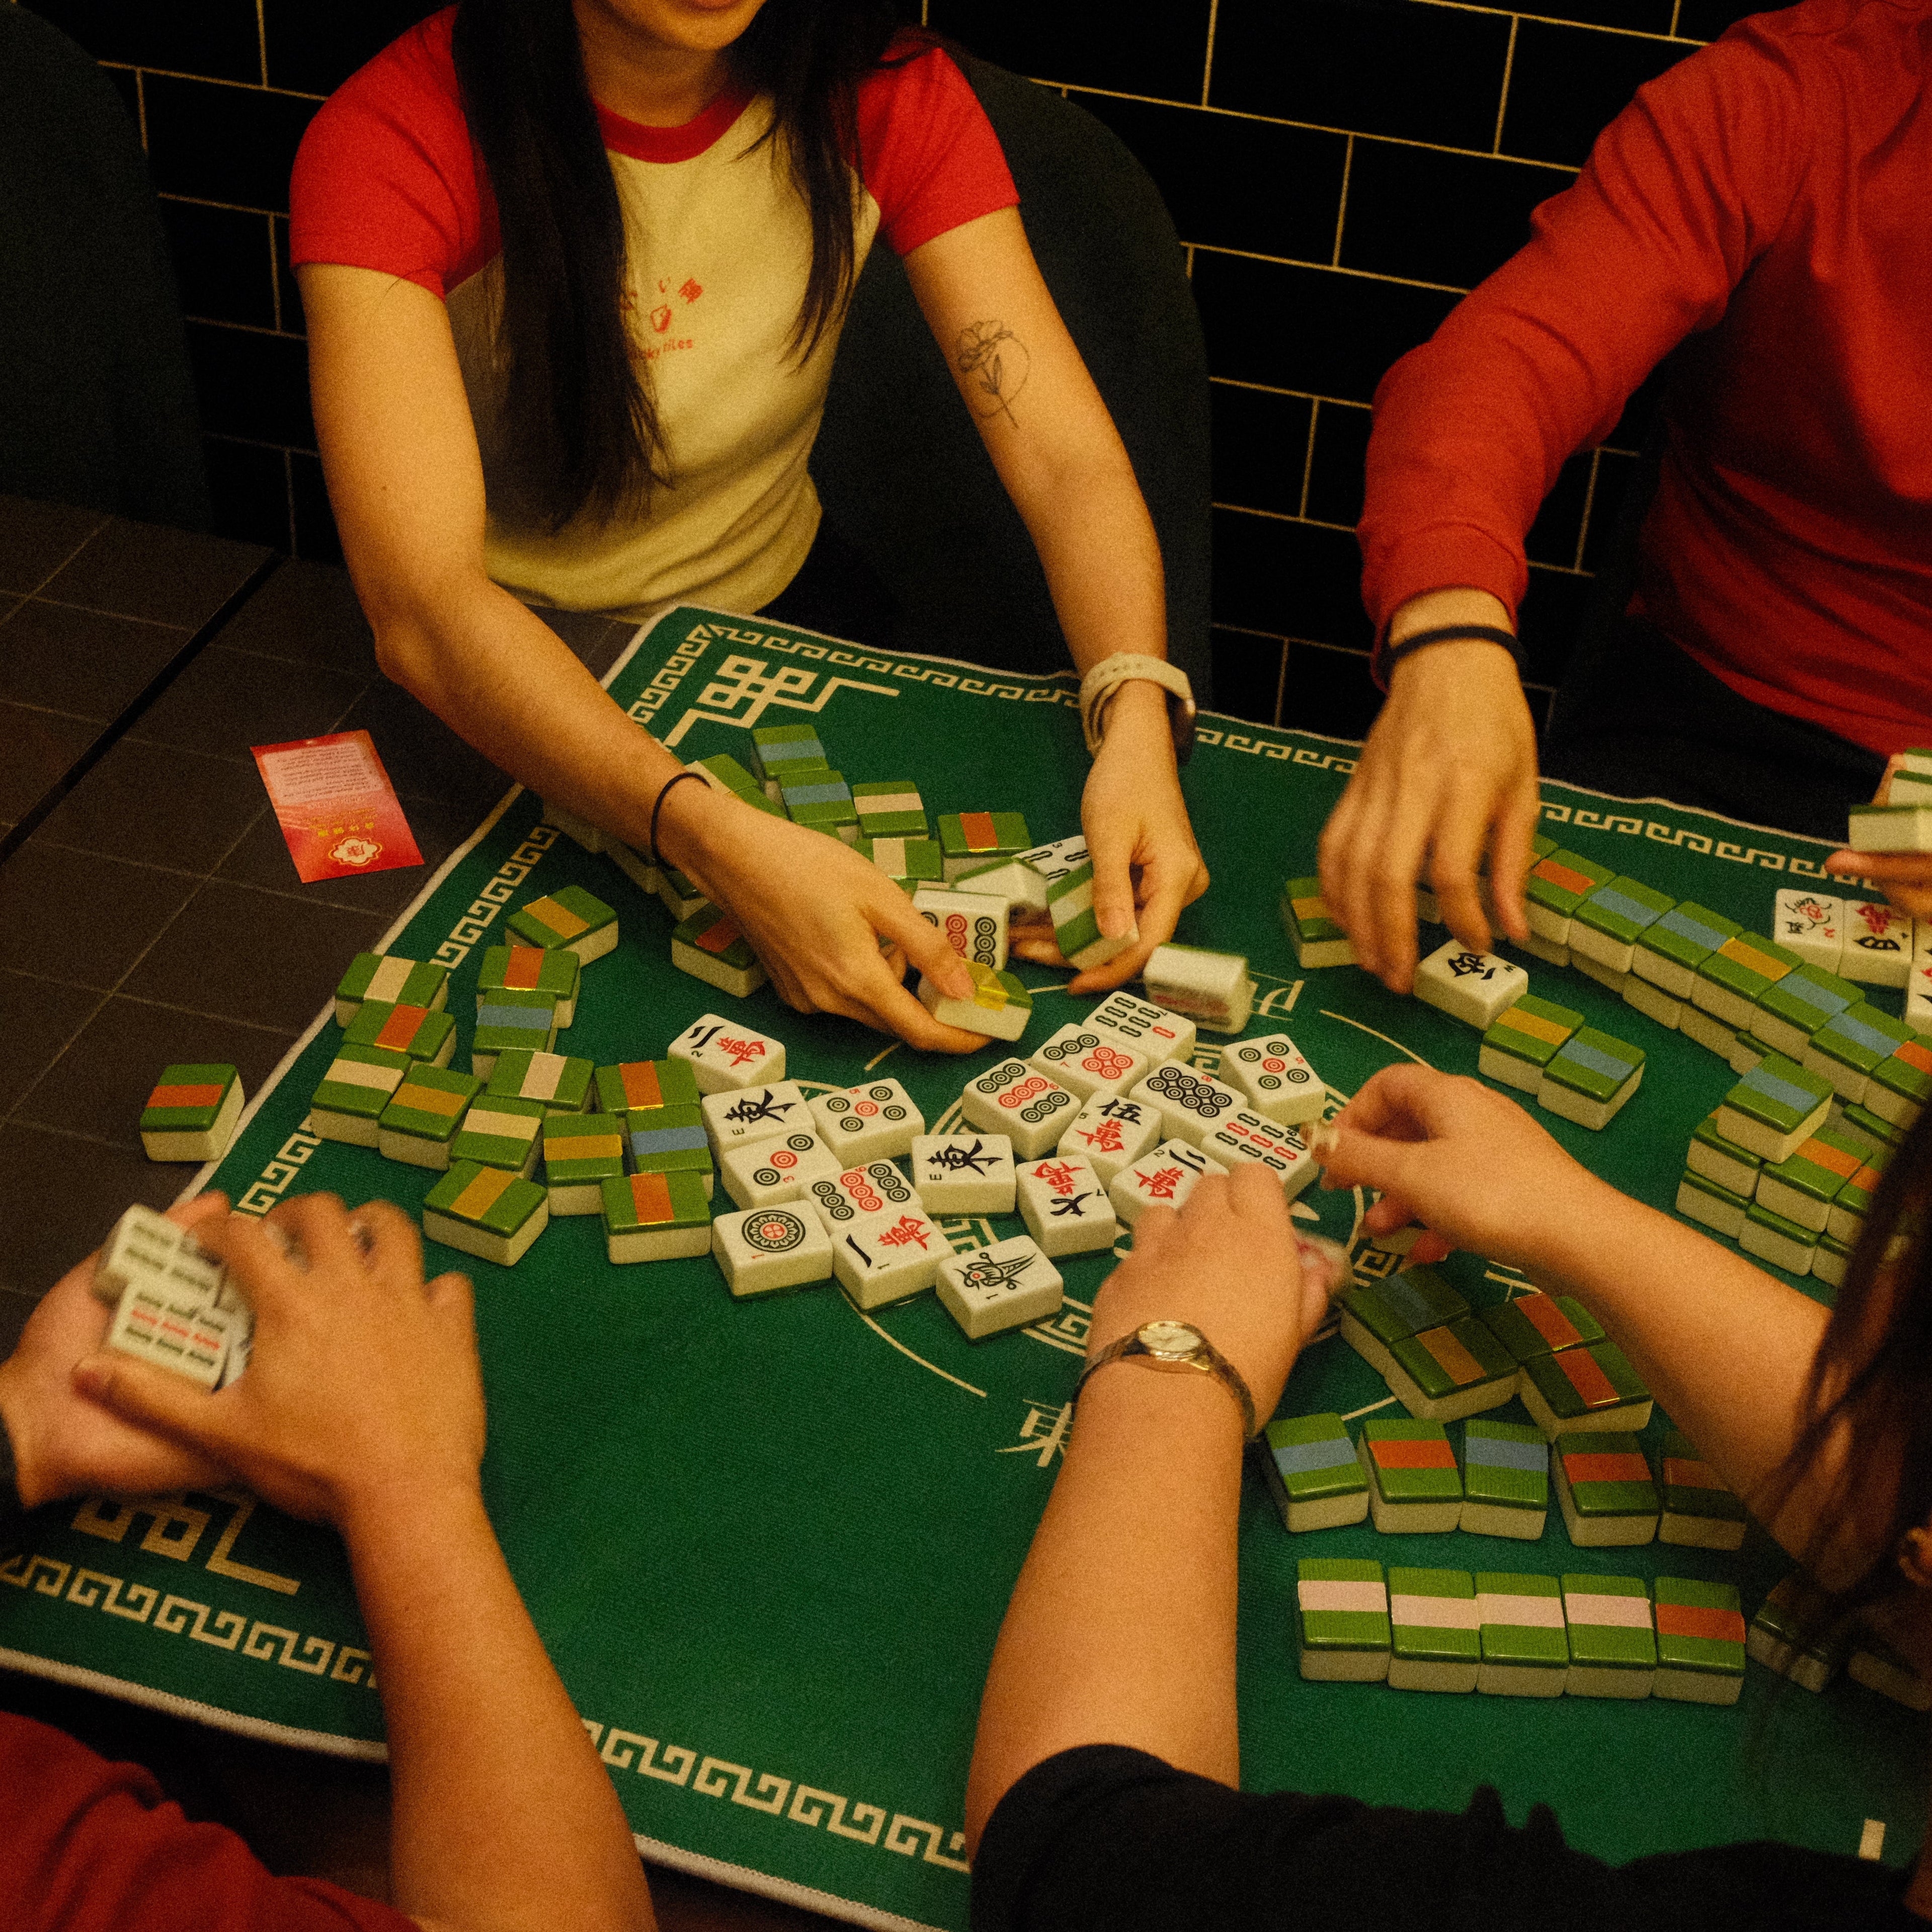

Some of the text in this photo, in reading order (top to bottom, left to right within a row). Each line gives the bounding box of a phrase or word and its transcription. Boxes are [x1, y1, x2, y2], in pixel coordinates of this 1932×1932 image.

[1823, 927, 1835, 938] 2
[723, 1089, 797, 1124] 東
[732, 1128, 745, 1136] E
[926, 1139, 1004, 1177] 東
[1154, 1149, 1165, 1157] 2
